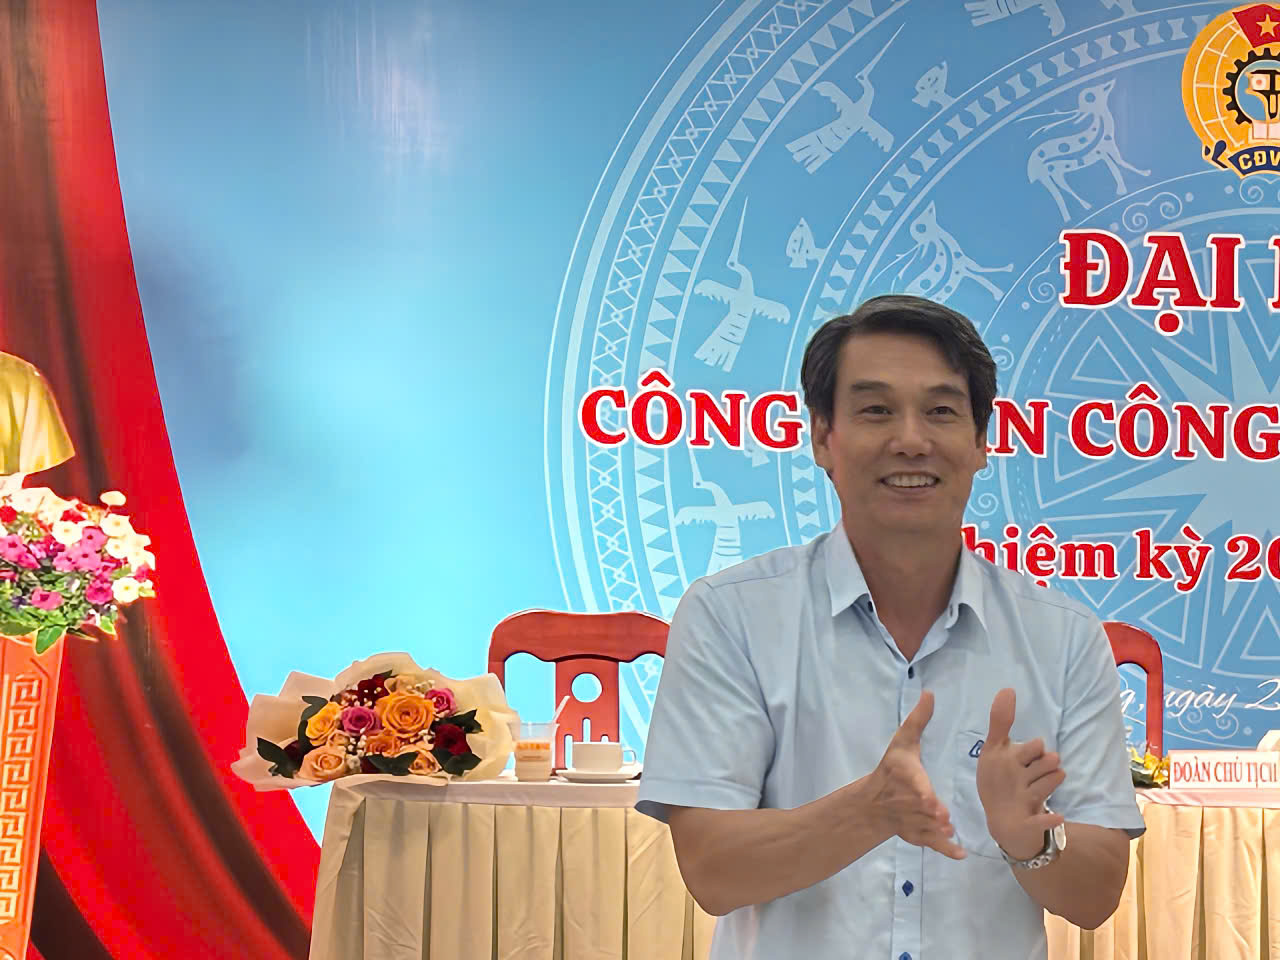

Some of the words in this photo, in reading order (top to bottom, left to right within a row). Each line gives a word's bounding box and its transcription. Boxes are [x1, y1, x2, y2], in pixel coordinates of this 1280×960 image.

[1062, 231, 1243, 335] ĐẠI
[580, 369, 804, 450] CÔNG
[961, 525, 1119, 588] hiệm
[1135, 524, 1213, 592] kỳ
[1173, 755, 1211, 783] ĐOÀN
[1214, 755, 1243, 783] CHỦ
[1246, 761, 1279, 789] TỊCH
